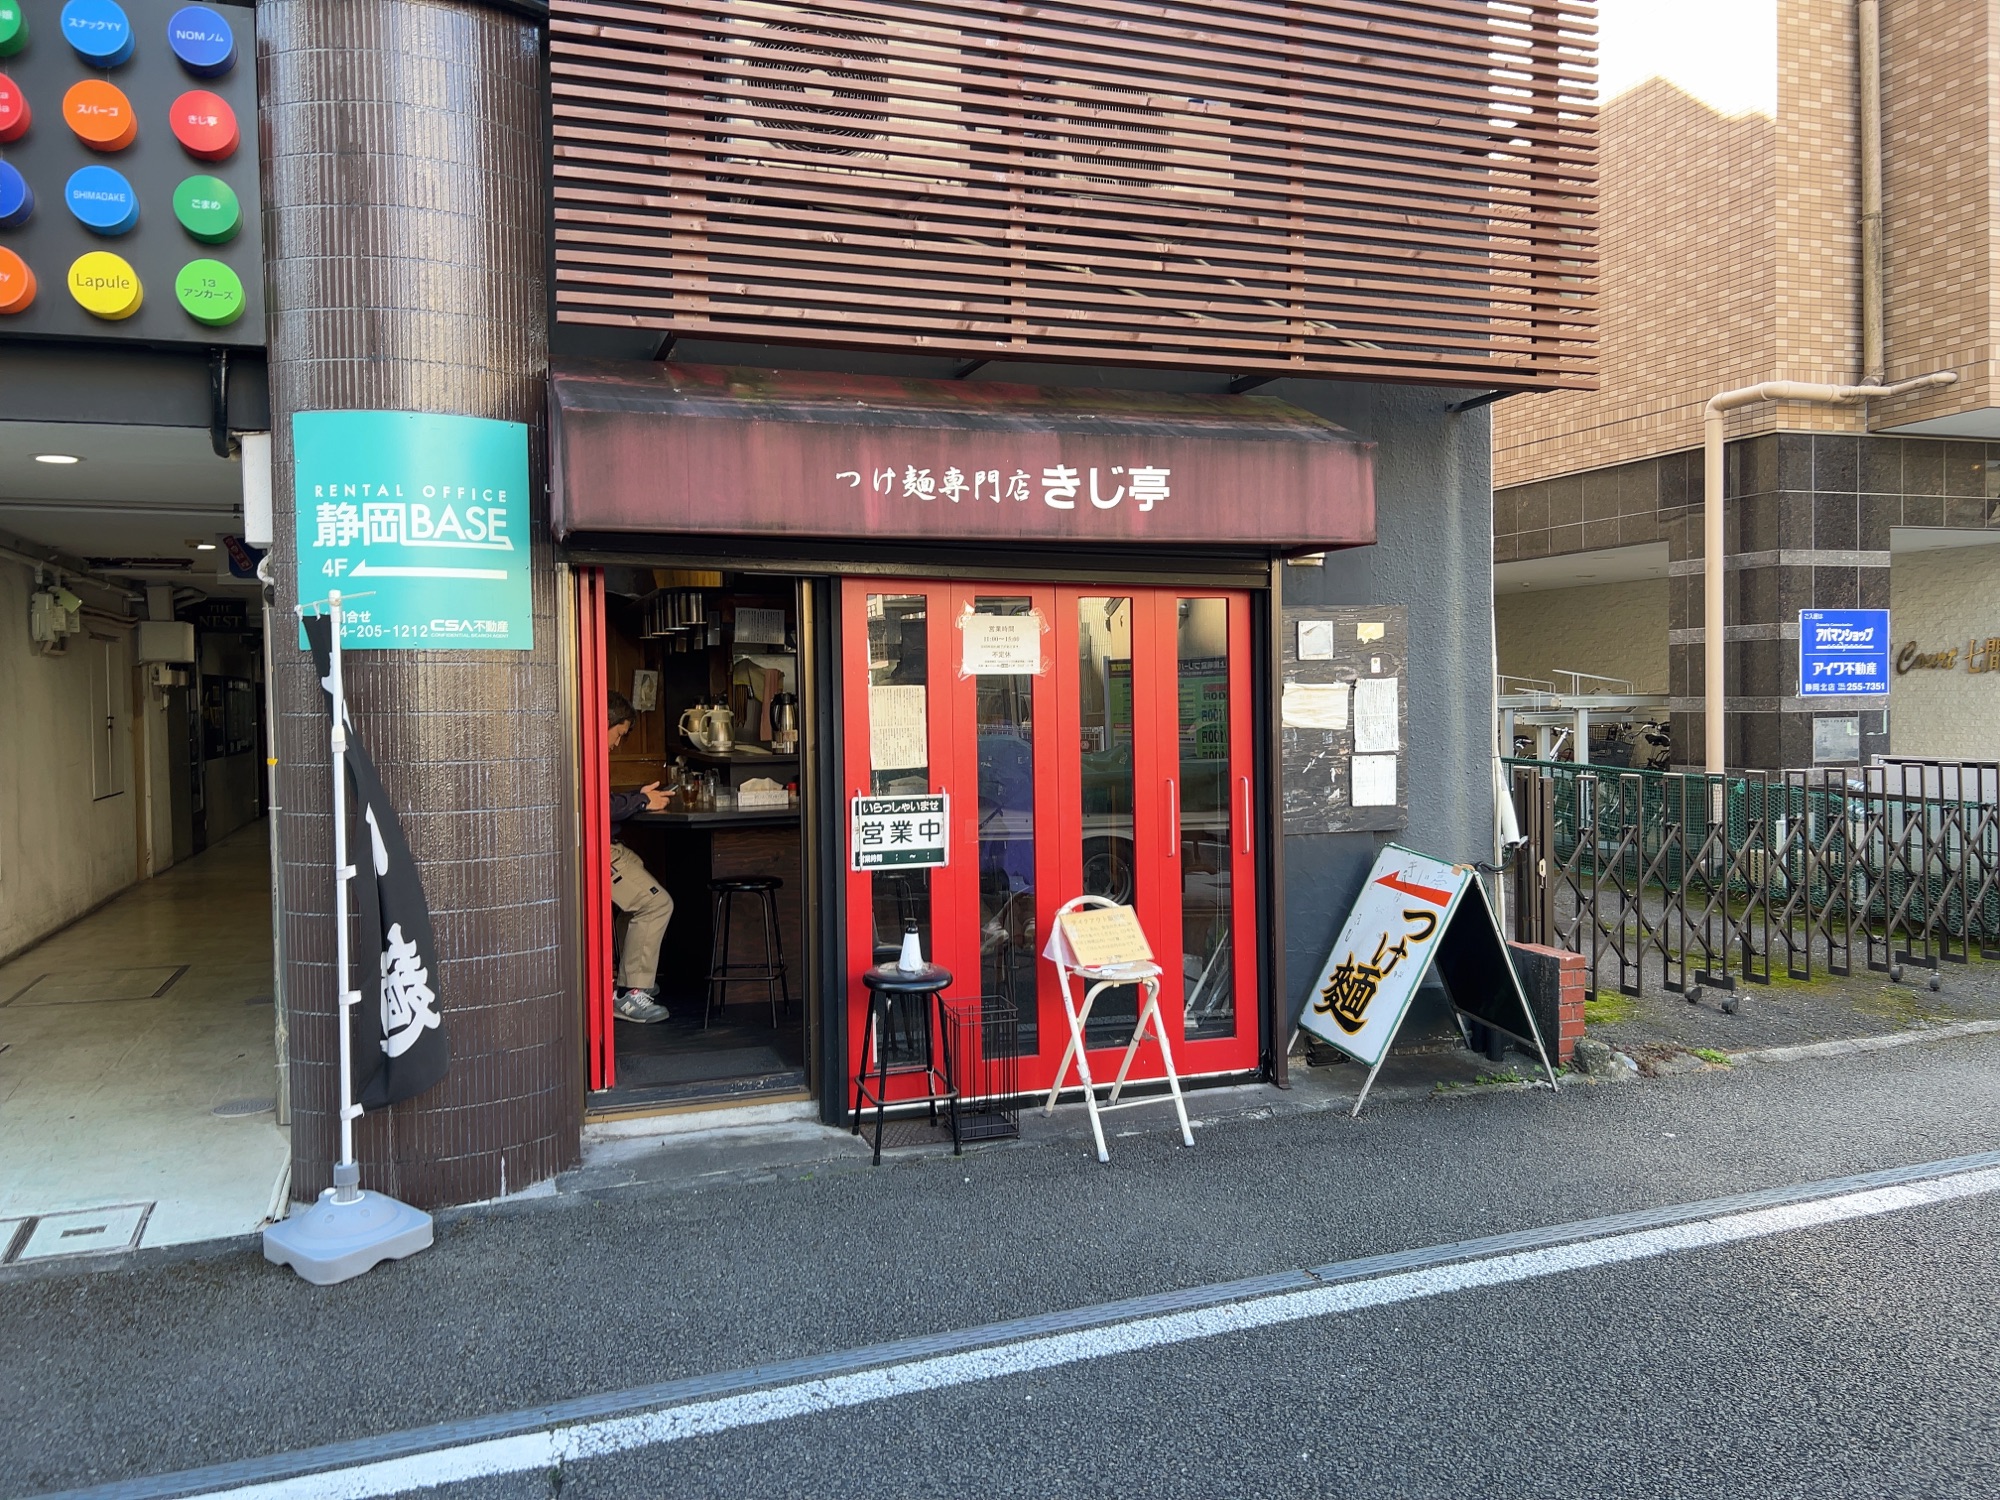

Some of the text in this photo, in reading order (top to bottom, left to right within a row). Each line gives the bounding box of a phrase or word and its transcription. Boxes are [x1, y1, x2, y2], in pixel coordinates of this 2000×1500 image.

[68, 17, 121, 32] スナックYY
[176, 29, 224, 43] NOM ノム
[73, 190, 126, 203] SHIMADAKE
[75, 273, 130, 290] Lapule
[202, 278, 216, 288] 13
[315, 484, 507, 503] RENTAL OFFICE
[1041, 464, 1171, 512] きじ亭
[313, 501, 515, 551] 静岡BASE
[322, 558, 348, 577] 4F
[199, 616, 243, 628] NEST
[1816, 627, 1874, 642] アパマンショップ
[1812, 662, 1877, 676] アイワ不動産
[1805, 683, 1835, 692] 静岡北店
[1846, 682, 1885, 691] 255-7351
[862, 800, 939, 814] いらっしゃいませ
[861, 818, 940, 845] 営業中
